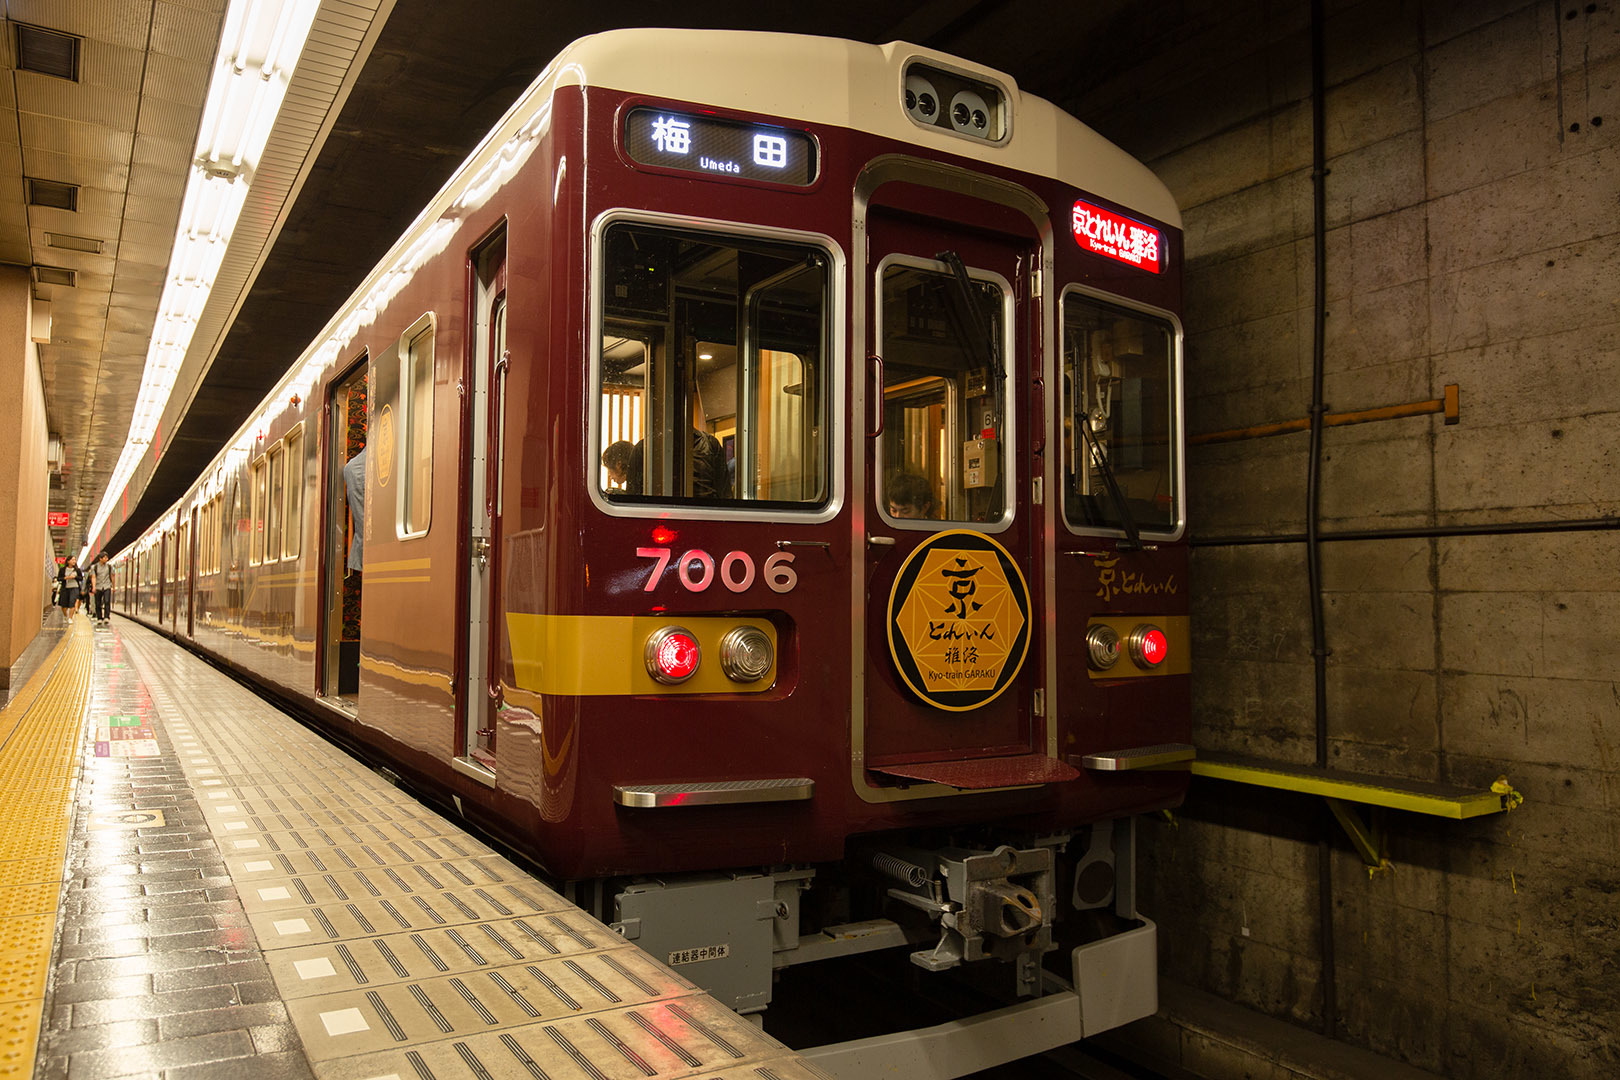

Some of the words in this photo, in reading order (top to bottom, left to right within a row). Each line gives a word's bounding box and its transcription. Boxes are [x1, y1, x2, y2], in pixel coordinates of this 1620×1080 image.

[700, 156, 741, 174] Umeda
[984, 414, 992, 426] 6
[636, 547, 798, 593] 7006
[942, 557, 985, 619] 京
[928, 621, 995, 641] とれいん
[944, 646, 980, 664] 雅洛
[928, 670, 963, 682] Kyo-train
[964, 669, 996, 679] GARAKU
[672, 946, 726, 965] 連結器中間体
